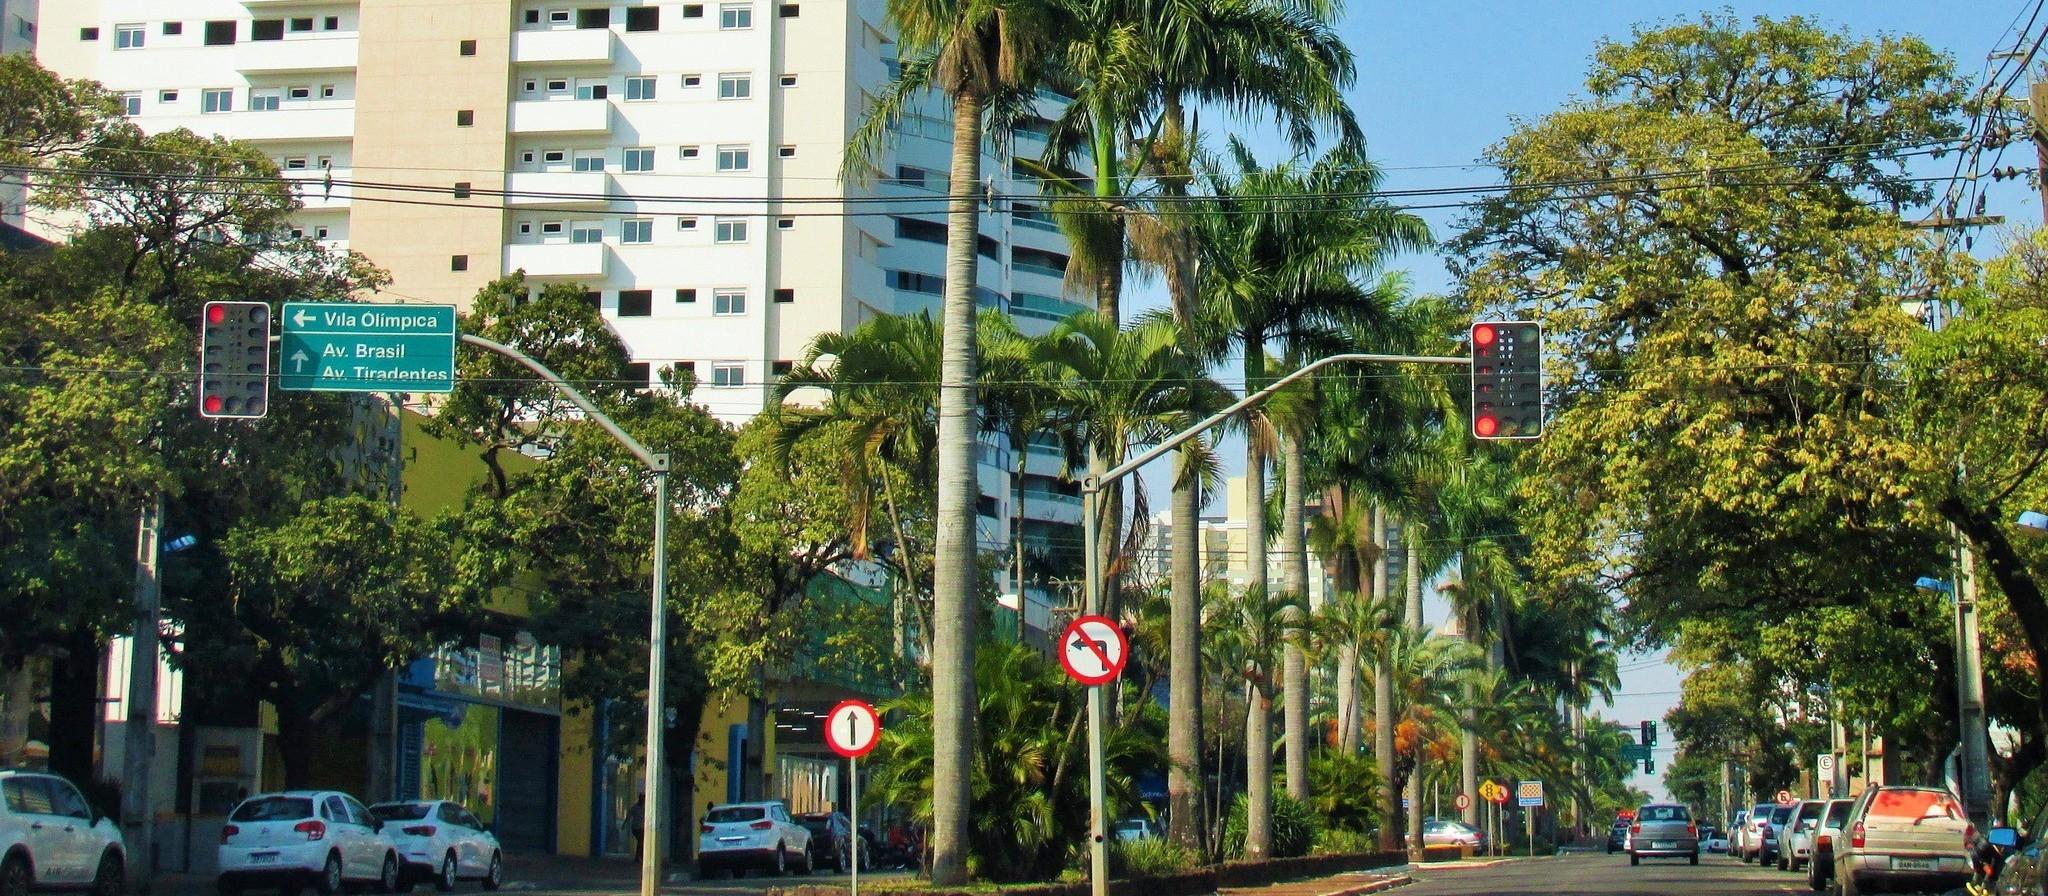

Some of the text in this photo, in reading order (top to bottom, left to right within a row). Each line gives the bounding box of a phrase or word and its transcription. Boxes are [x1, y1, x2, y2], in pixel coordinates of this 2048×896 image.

[324, 311, 356, 327] Vila
[323, 343, 405, 358] Av. Brasil
[321, 365, 448, 382] Av. Tiradentes
